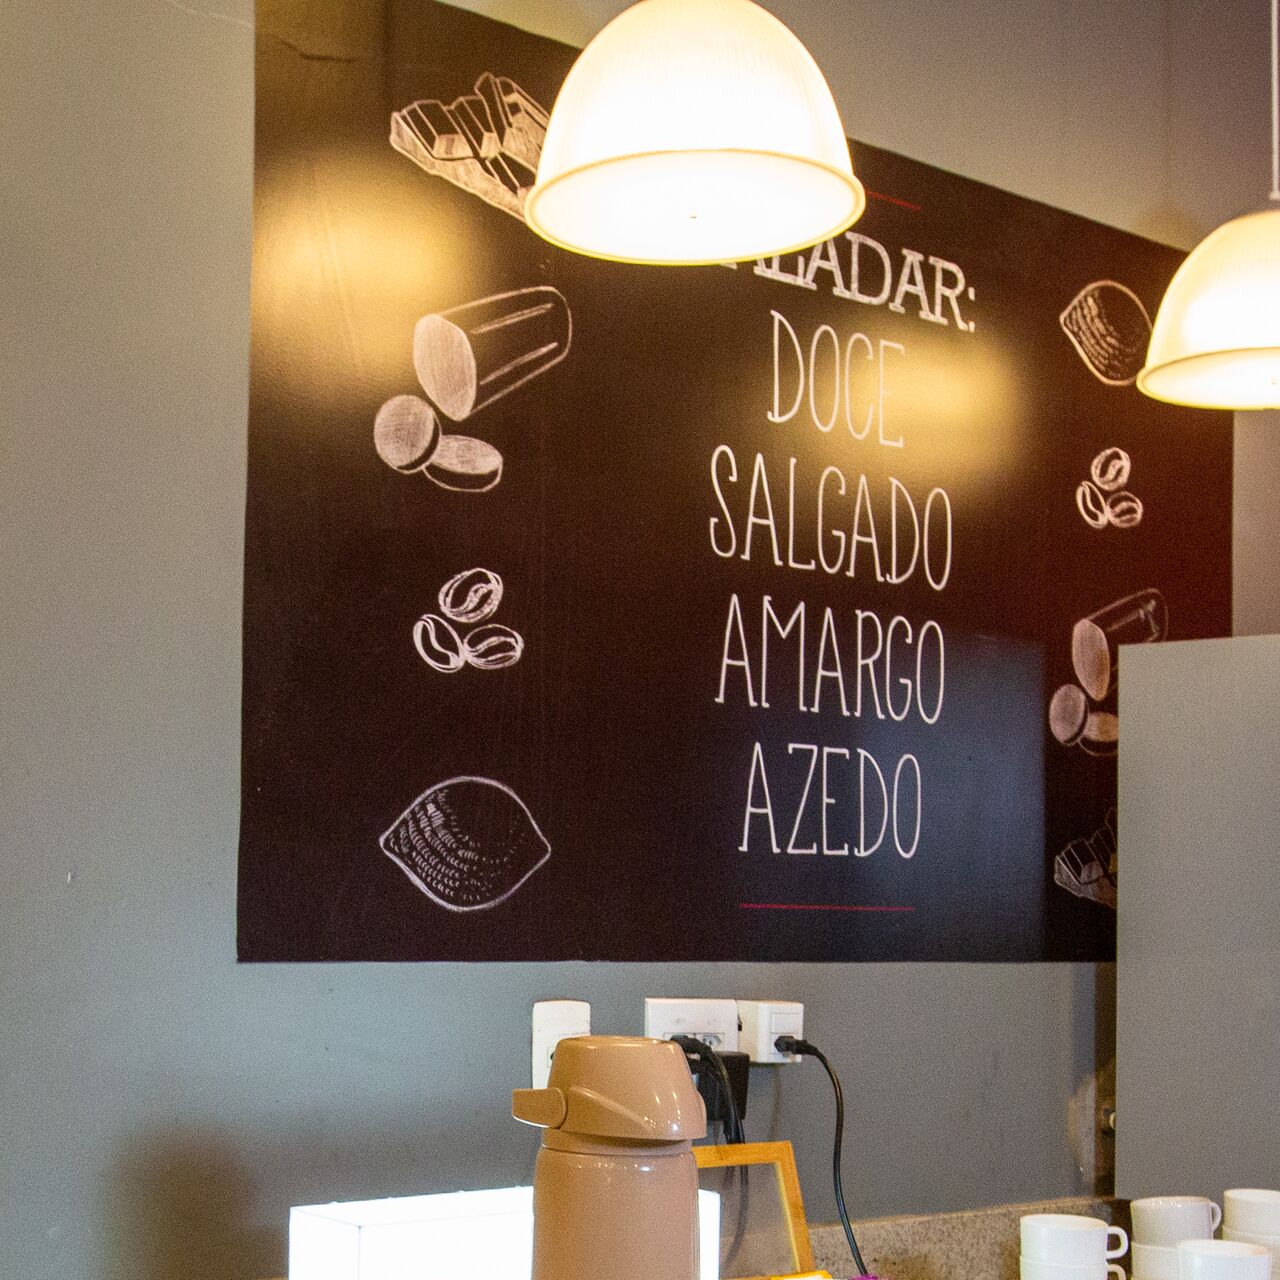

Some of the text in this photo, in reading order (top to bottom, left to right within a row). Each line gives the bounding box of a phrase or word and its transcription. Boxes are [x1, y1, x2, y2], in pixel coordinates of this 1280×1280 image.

[720, 231, 976, 333] LADAR:
[767, 309, 905, 448] DOCE
[709, 444, 952, 591] SALGADO
[714, 593, 945, 725] AMARGO
[738, 741, 921, 859] AZEDO
